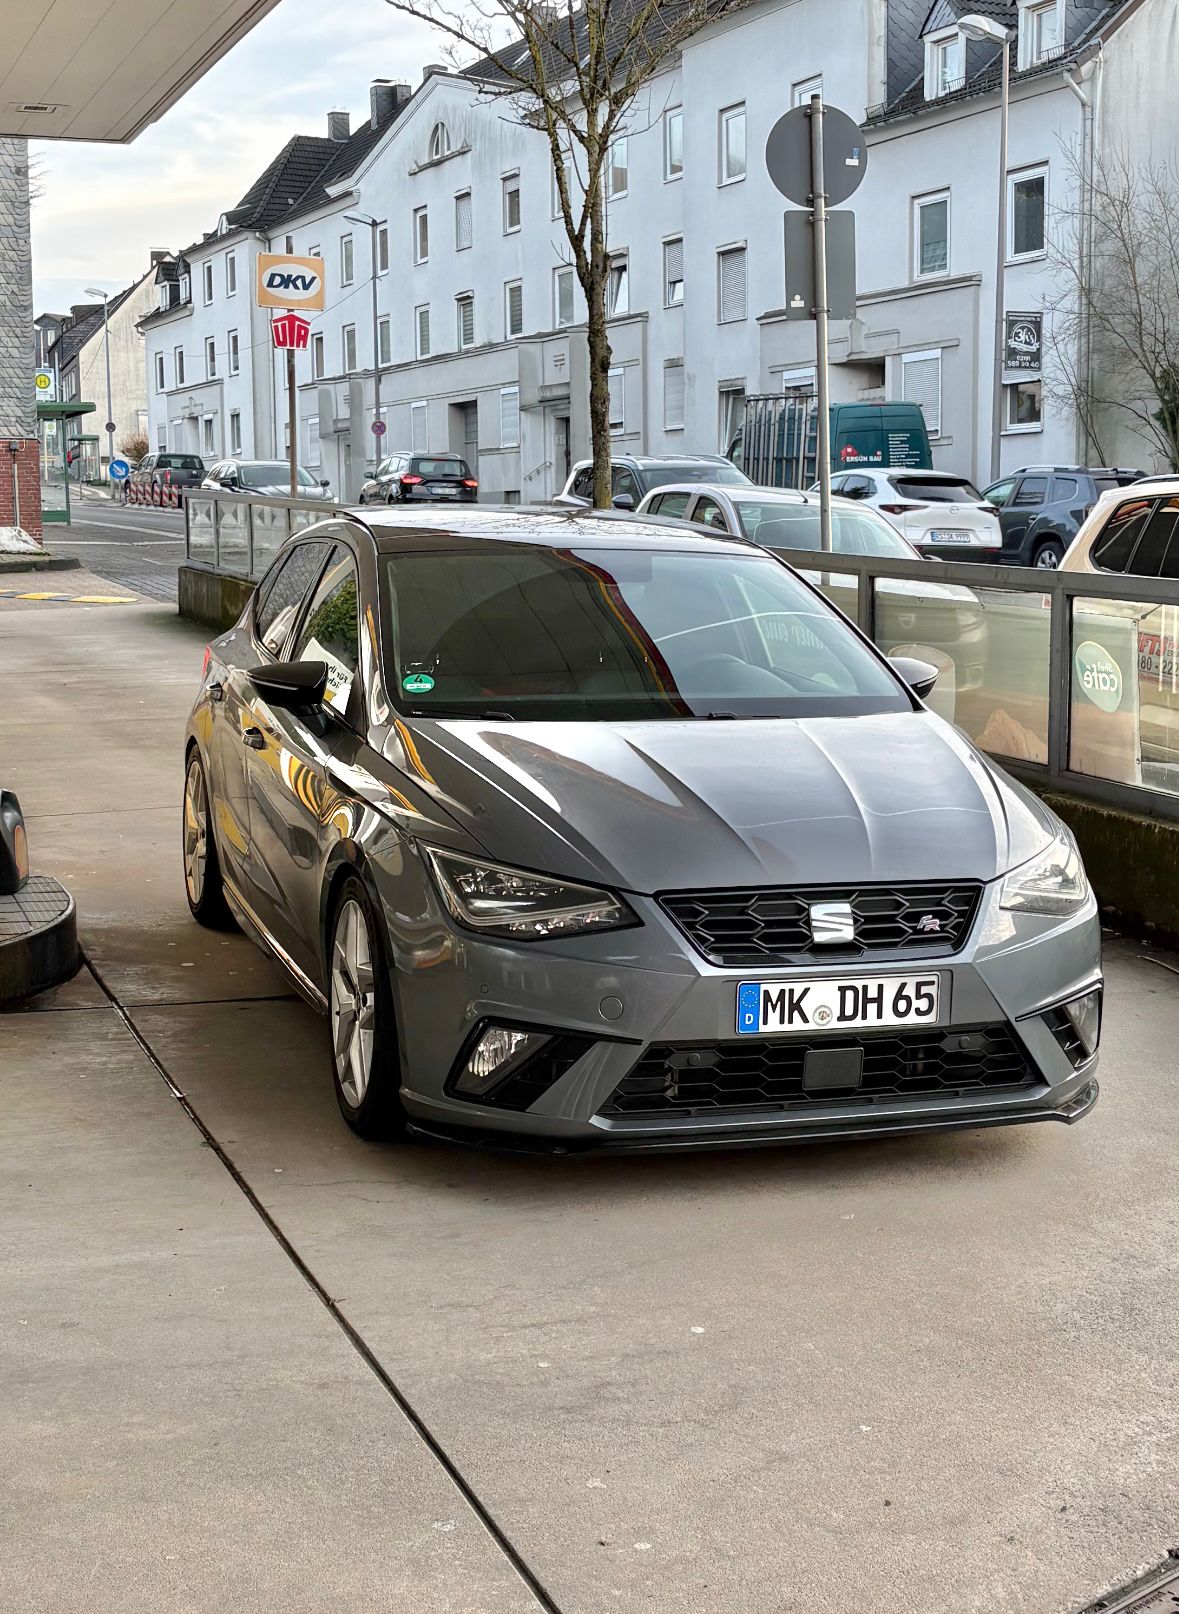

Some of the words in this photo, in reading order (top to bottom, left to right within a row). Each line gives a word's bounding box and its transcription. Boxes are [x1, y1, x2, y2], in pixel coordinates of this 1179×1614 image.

[266, 273, 317, 291] DKV
[272, 313, 311, 349] UTA
[414, 674, 424, 683] 4
[917, 914, 941, 931] FR
[744, 1013, 754, 1024] D
[762, 987, 811, 1026] MK
[836, 983, 884, 1022] DH
[892, 980, 936, 1018] 65
